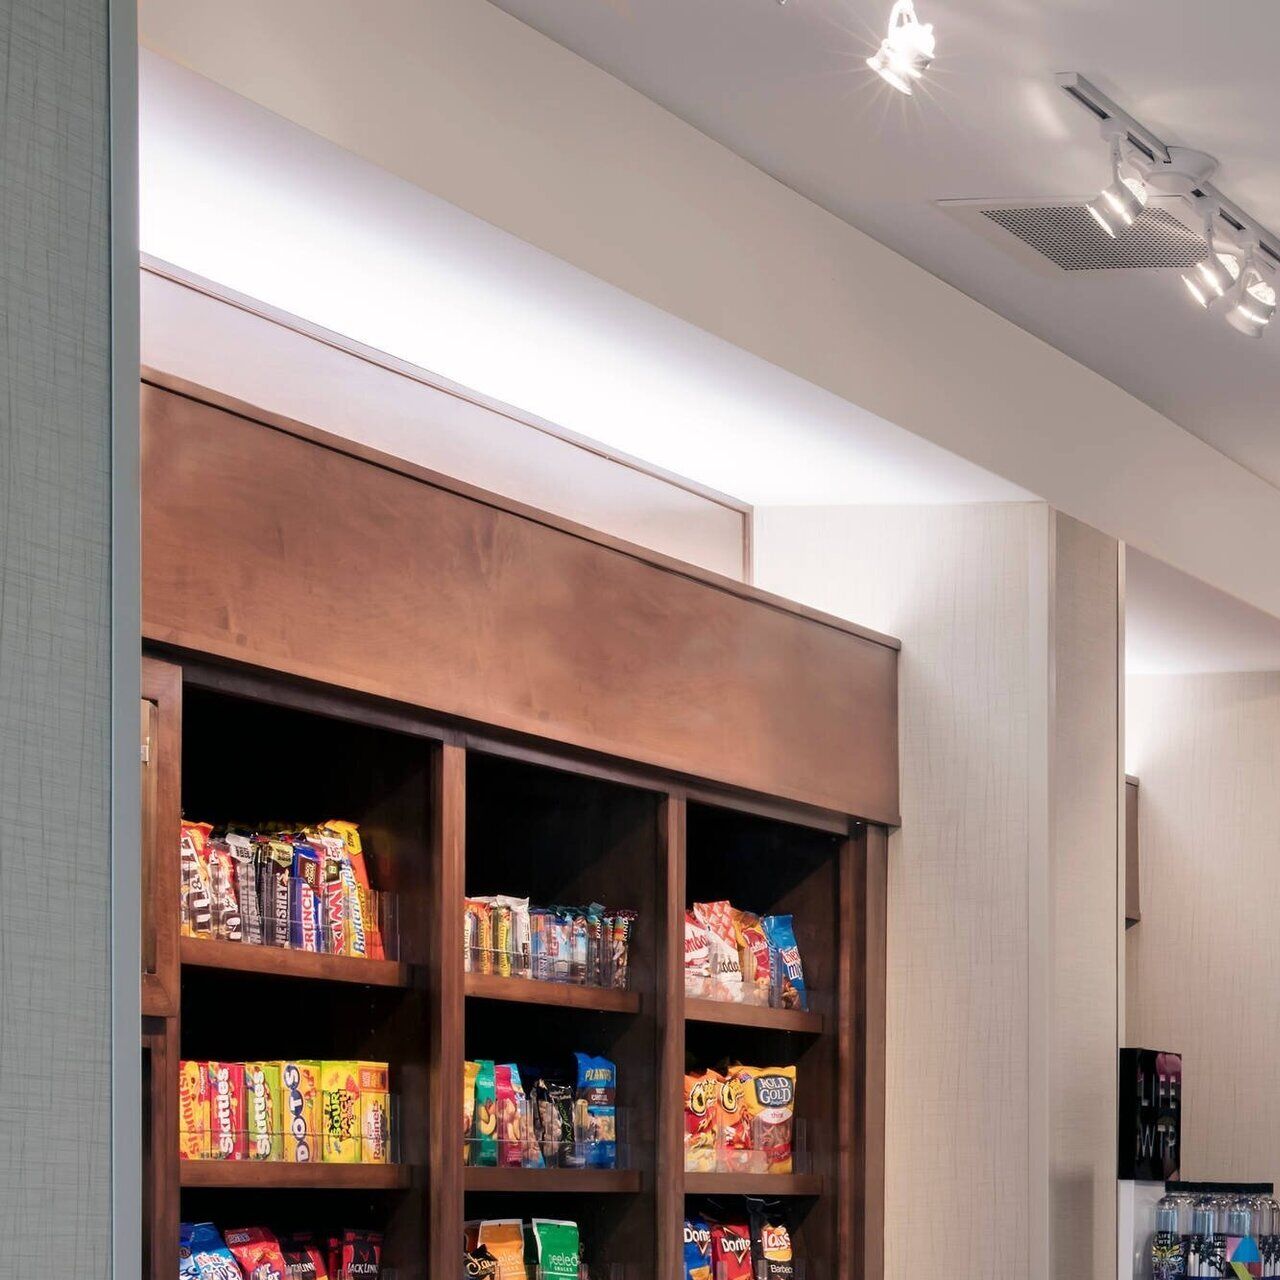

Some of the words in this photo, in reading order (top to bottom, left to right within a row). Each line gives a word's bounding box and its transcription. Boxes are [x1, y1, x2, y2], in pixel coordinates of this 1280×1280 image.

[302, 883, 317, 952] CRUNCH
[760, 1077, 789, 1089] ROLD
[760, 1087, 792, 1104] GOLD
[1140, 1072, 1176, 1109] LIFE
[216, 1068, 234, 1154] Skittles
[253, 1070, 271, 1155] Skittles
[284, 1066, 309, 1162] DOTS
[330, 1091, 341, 1139] SOUR
[339, 1089, 351, 1142] PATCH
[372, 1099, 382, 1160] Raisinets
[1140, 1123, 1176, 1159] WTR
